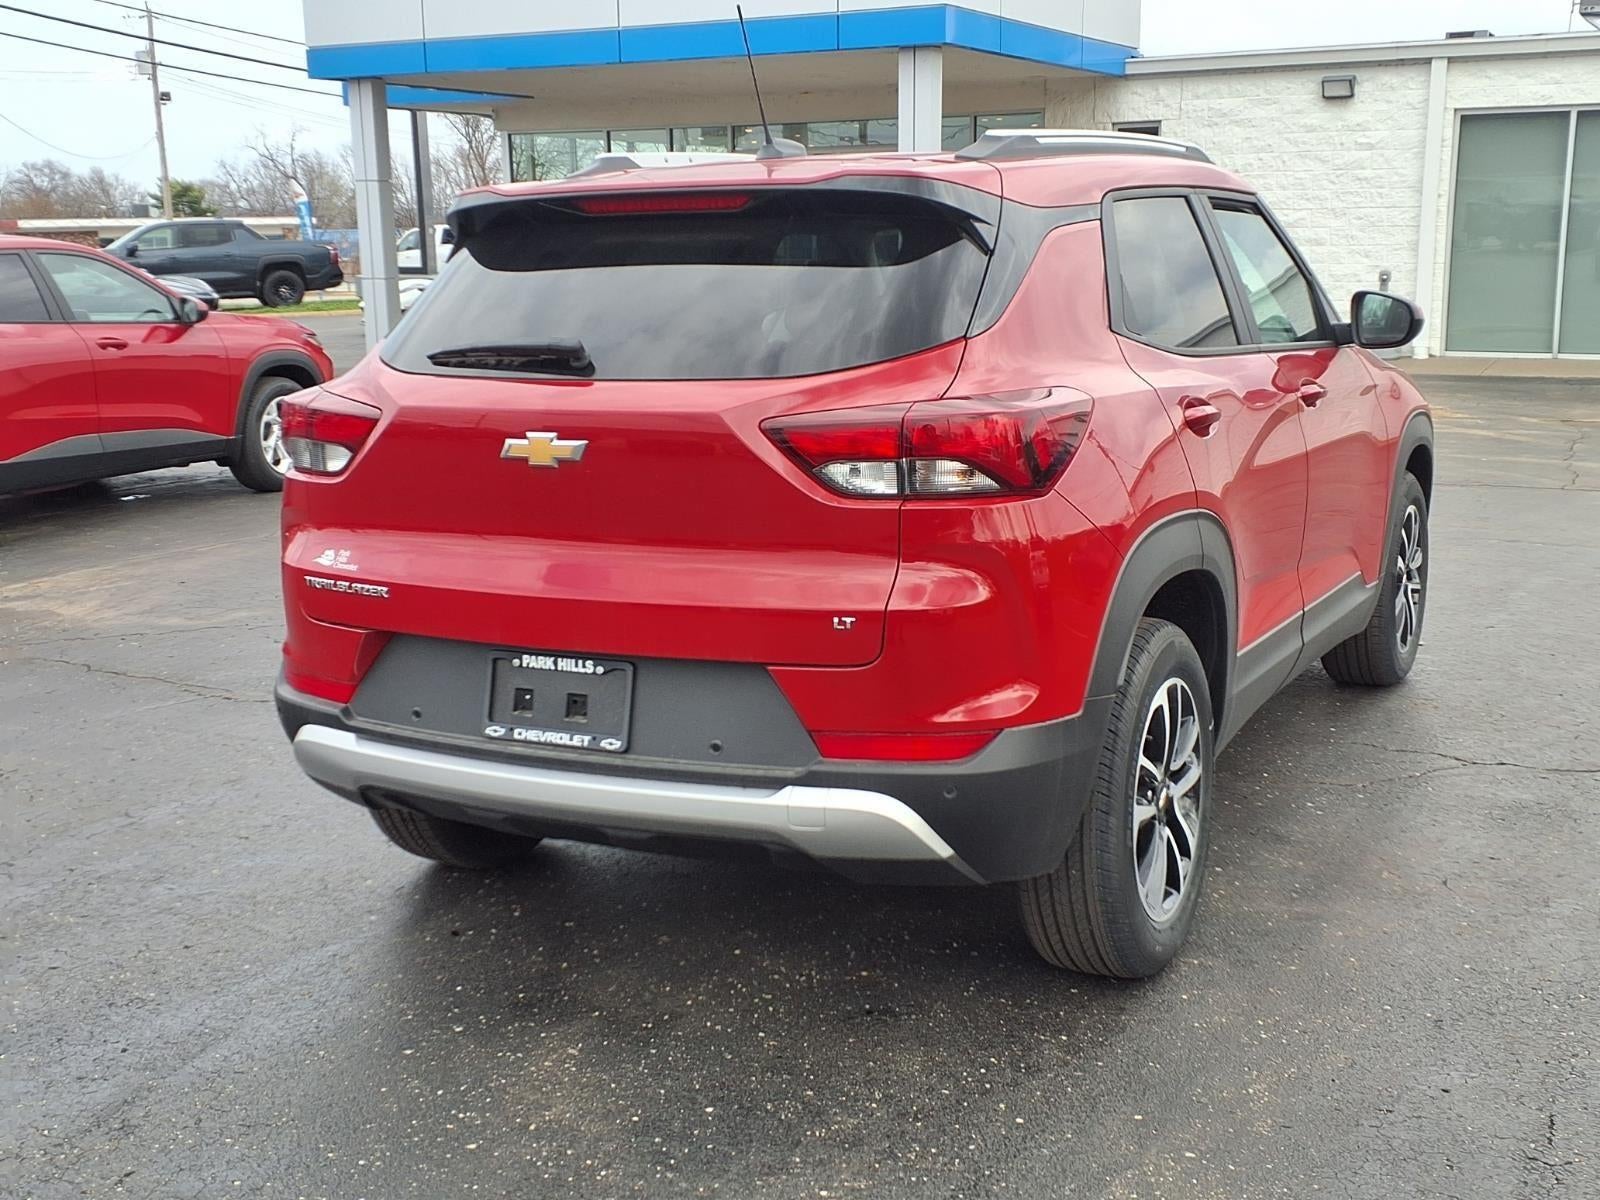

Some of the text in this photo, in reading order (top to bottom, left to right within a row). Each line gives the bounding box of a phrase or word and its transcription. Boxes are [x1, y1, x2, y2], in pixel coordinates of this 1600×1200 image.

[303, 575, 389, 598] TRAILBLAZER
[833, 616, 856, 630] LT
[521, 655, 595, 674] PARK HILLS
[513, 728, 592, 747] CHEVROLET
